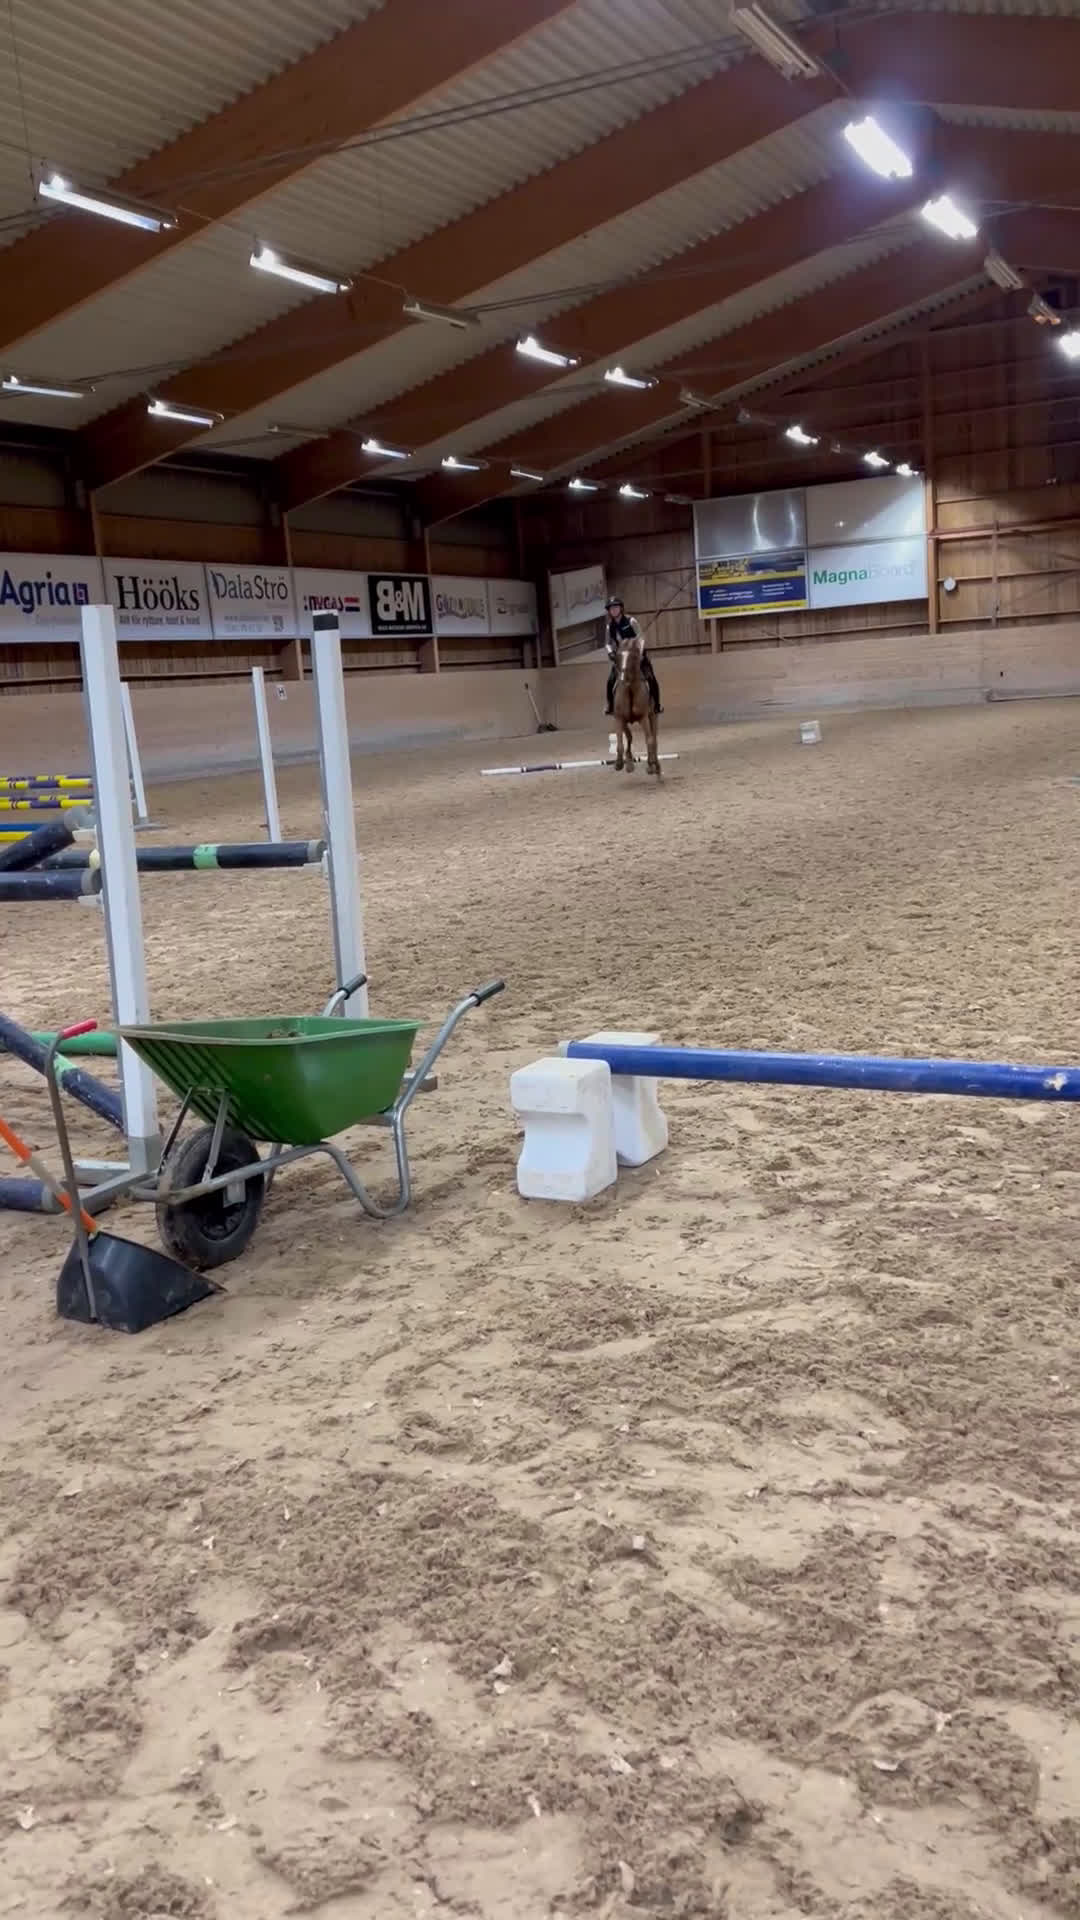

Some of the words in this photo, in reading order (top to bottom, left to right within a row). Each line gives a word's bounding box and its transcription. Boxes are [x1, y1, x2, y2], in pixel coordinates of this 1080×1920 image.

[0, 569, 72, 614] Agria
[113, 575, 200, 612] Hööks
[376, 580, 426, 621] B&M
